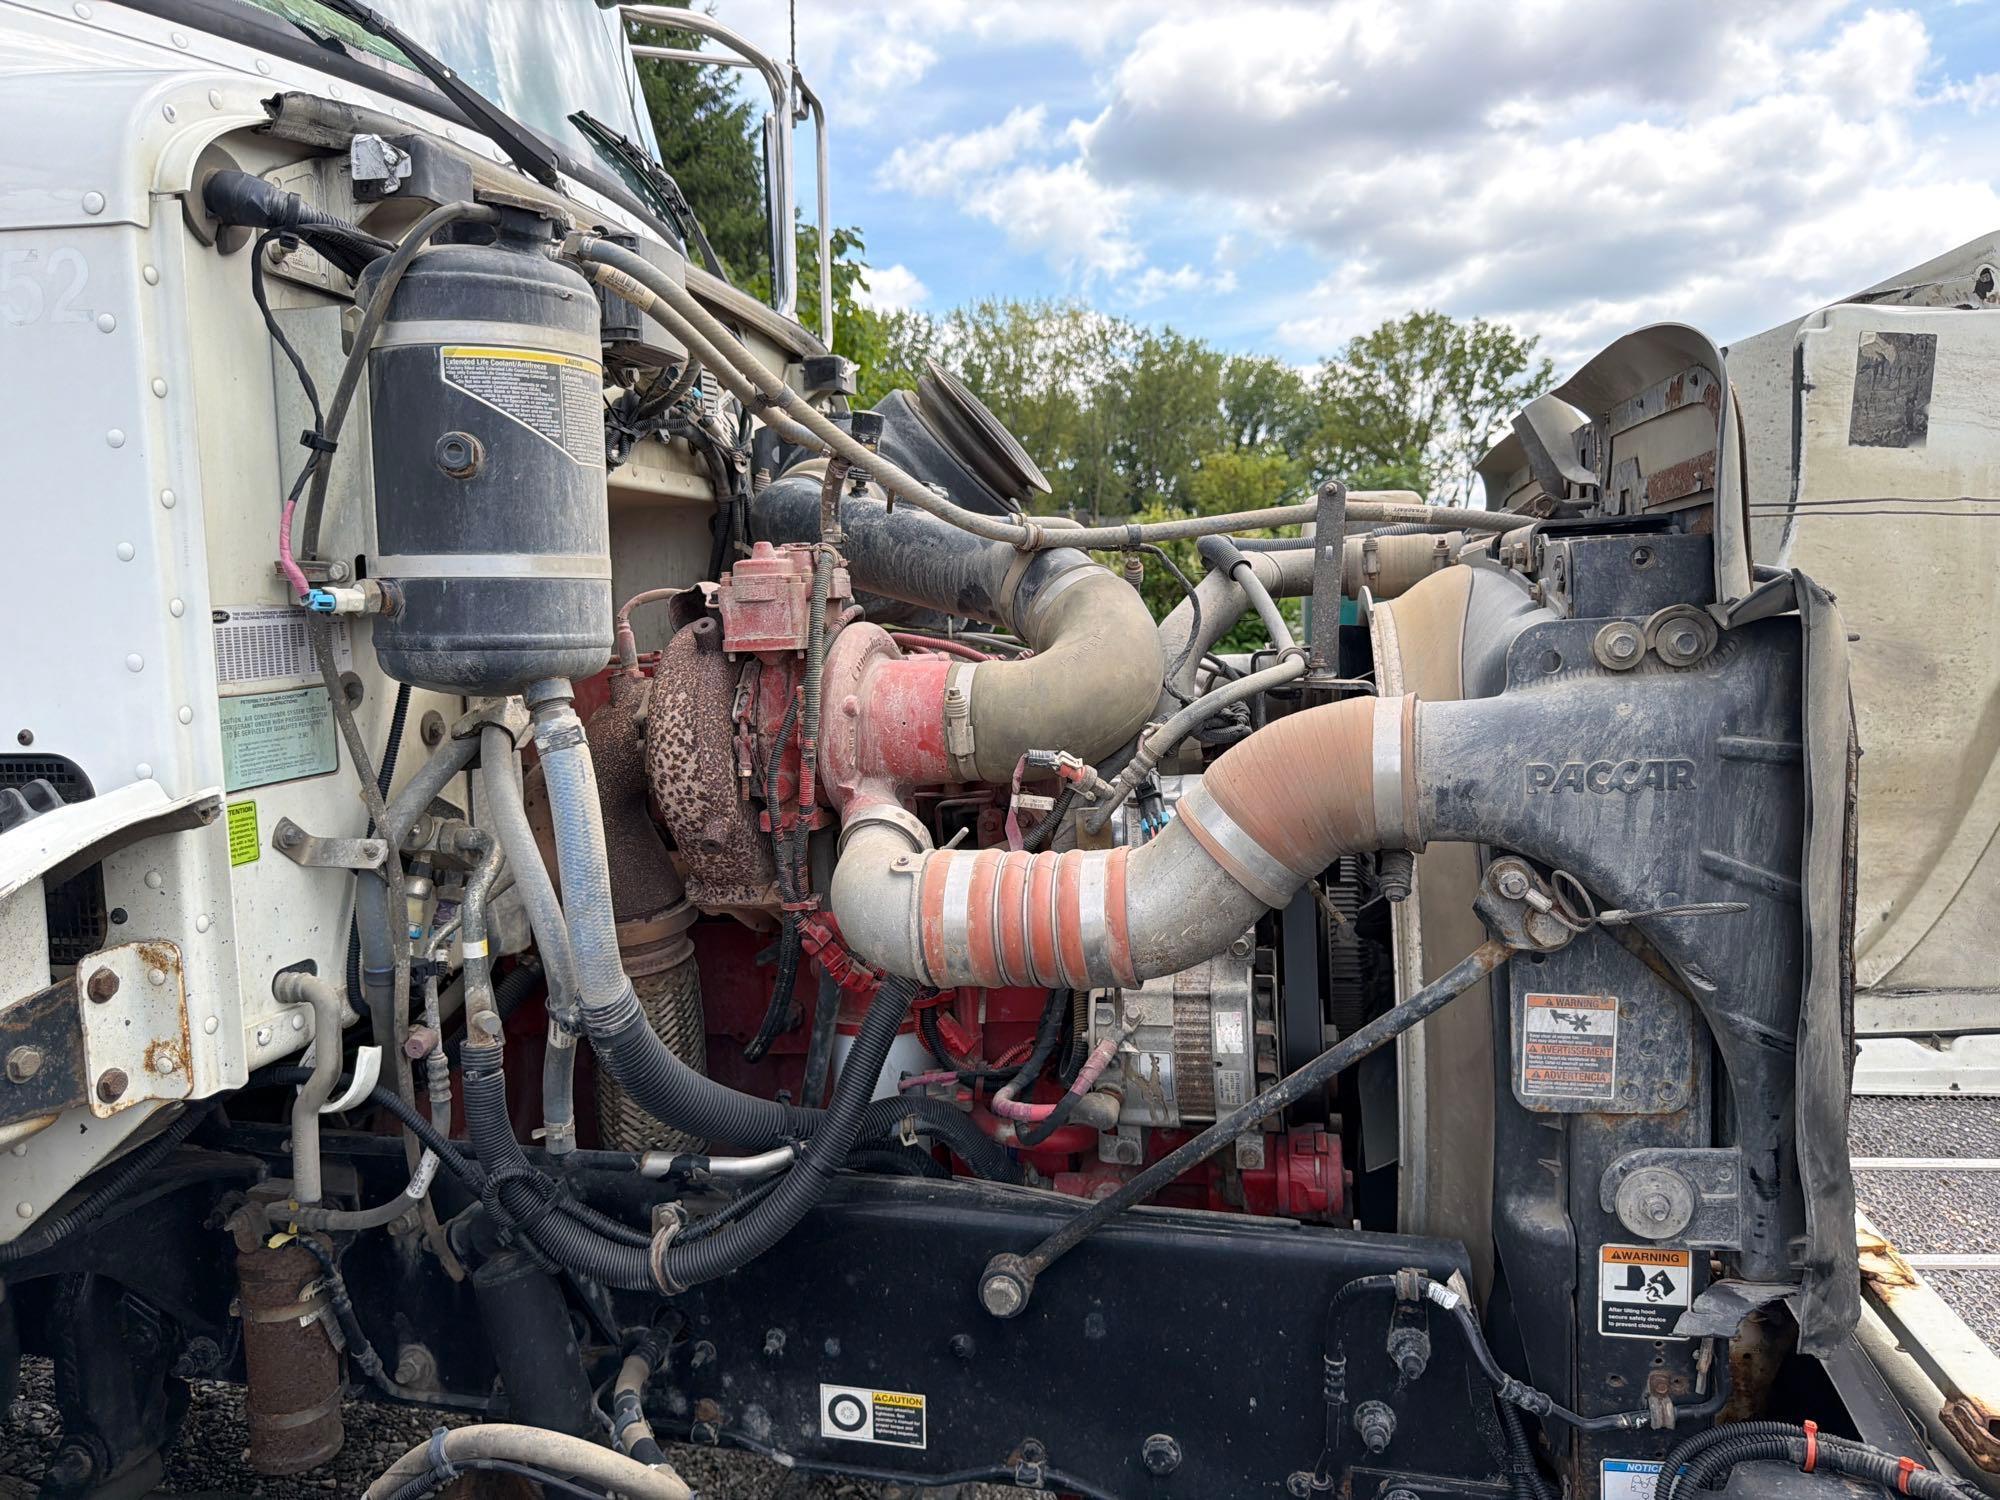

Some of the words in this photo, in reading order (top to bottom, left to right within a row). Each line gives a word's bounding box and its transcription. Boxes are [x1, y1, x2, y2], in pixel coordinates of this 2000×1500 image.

[446, 358, 476, 366] Extended
[476, 358, 489, 366] Life
[490, 359, 547, 370] Coolant/Antifreeze
[242, 726, 266, 736] SERVICED
[274, 722, 298, 732] QUALIFIED
[254, 719, 272, 728] UNDER
[1525, 758, 1697, 795] PACCAR
[1556, 998, 1600, 1008] WARNING
[1541, 1045, 1612, 1057] AVERTISSEMENT
[1544, 1070, 1606, 1082] ADVERTENCIA
[1622, 1252, 1680, 1262] WARNING
[882, 1394, 922, 1406] CAUTION
